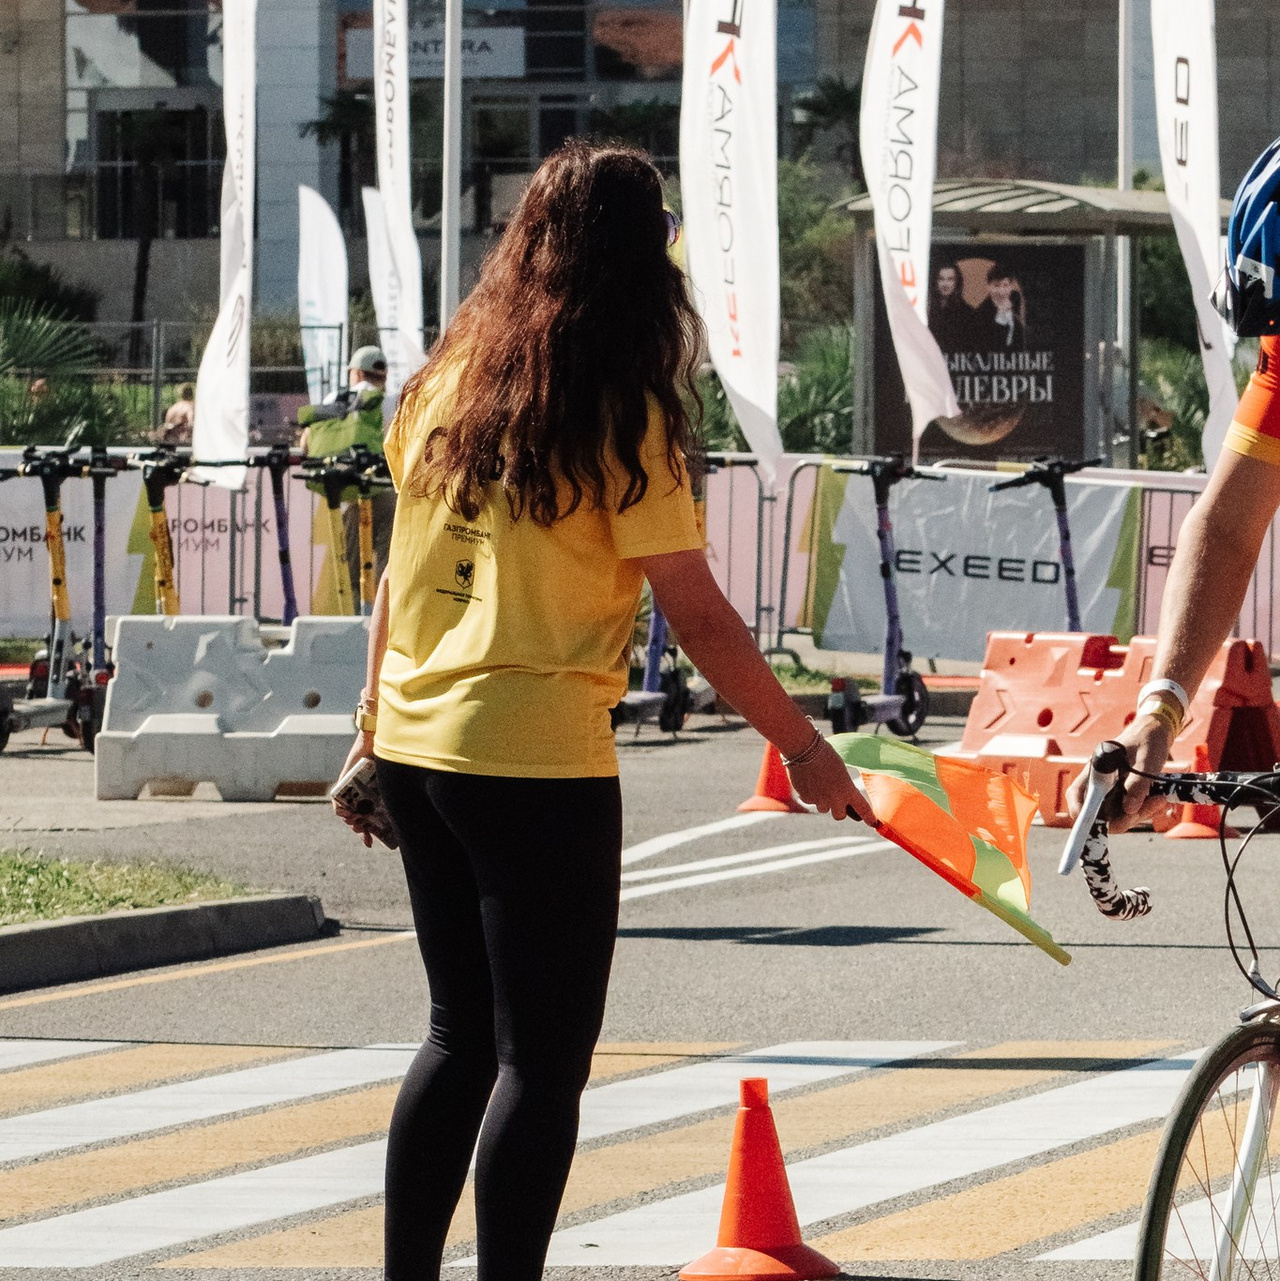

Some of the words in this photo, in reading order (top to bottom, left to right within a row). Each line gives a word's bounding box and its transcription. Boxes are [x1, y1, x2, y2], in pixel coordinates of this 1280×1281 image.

[944, 351, 1053, 371] ЫКАЛЬНЫЕ
[953, 375, 1054, 403] ДЕВРЫ
[895, 550, 1061, 584] EXEED
